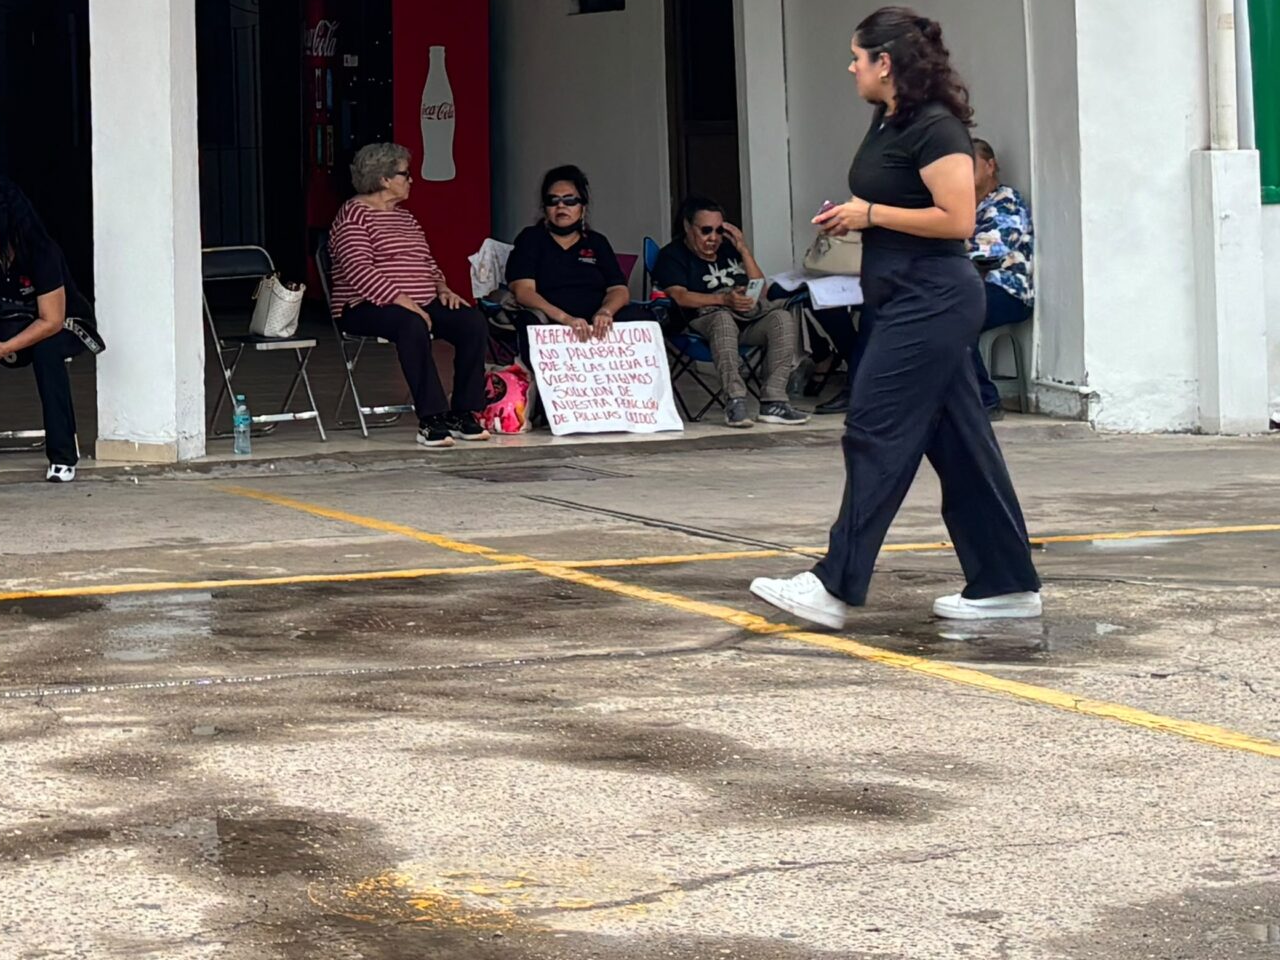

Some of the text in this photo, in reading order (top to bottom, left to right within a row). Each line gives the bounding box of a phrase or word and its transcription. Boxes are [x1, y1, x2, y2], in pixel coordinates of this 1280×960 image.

[534, 327, 578, 344] KEREMO
[539, 345, 636, 361] NO PALABRAS
[645, 355, 659, 368] EL
[618, 385, 634, 397] DE
[551, 398, 612, 412] NUESTRA
[552, 414, 569, 426] DE
